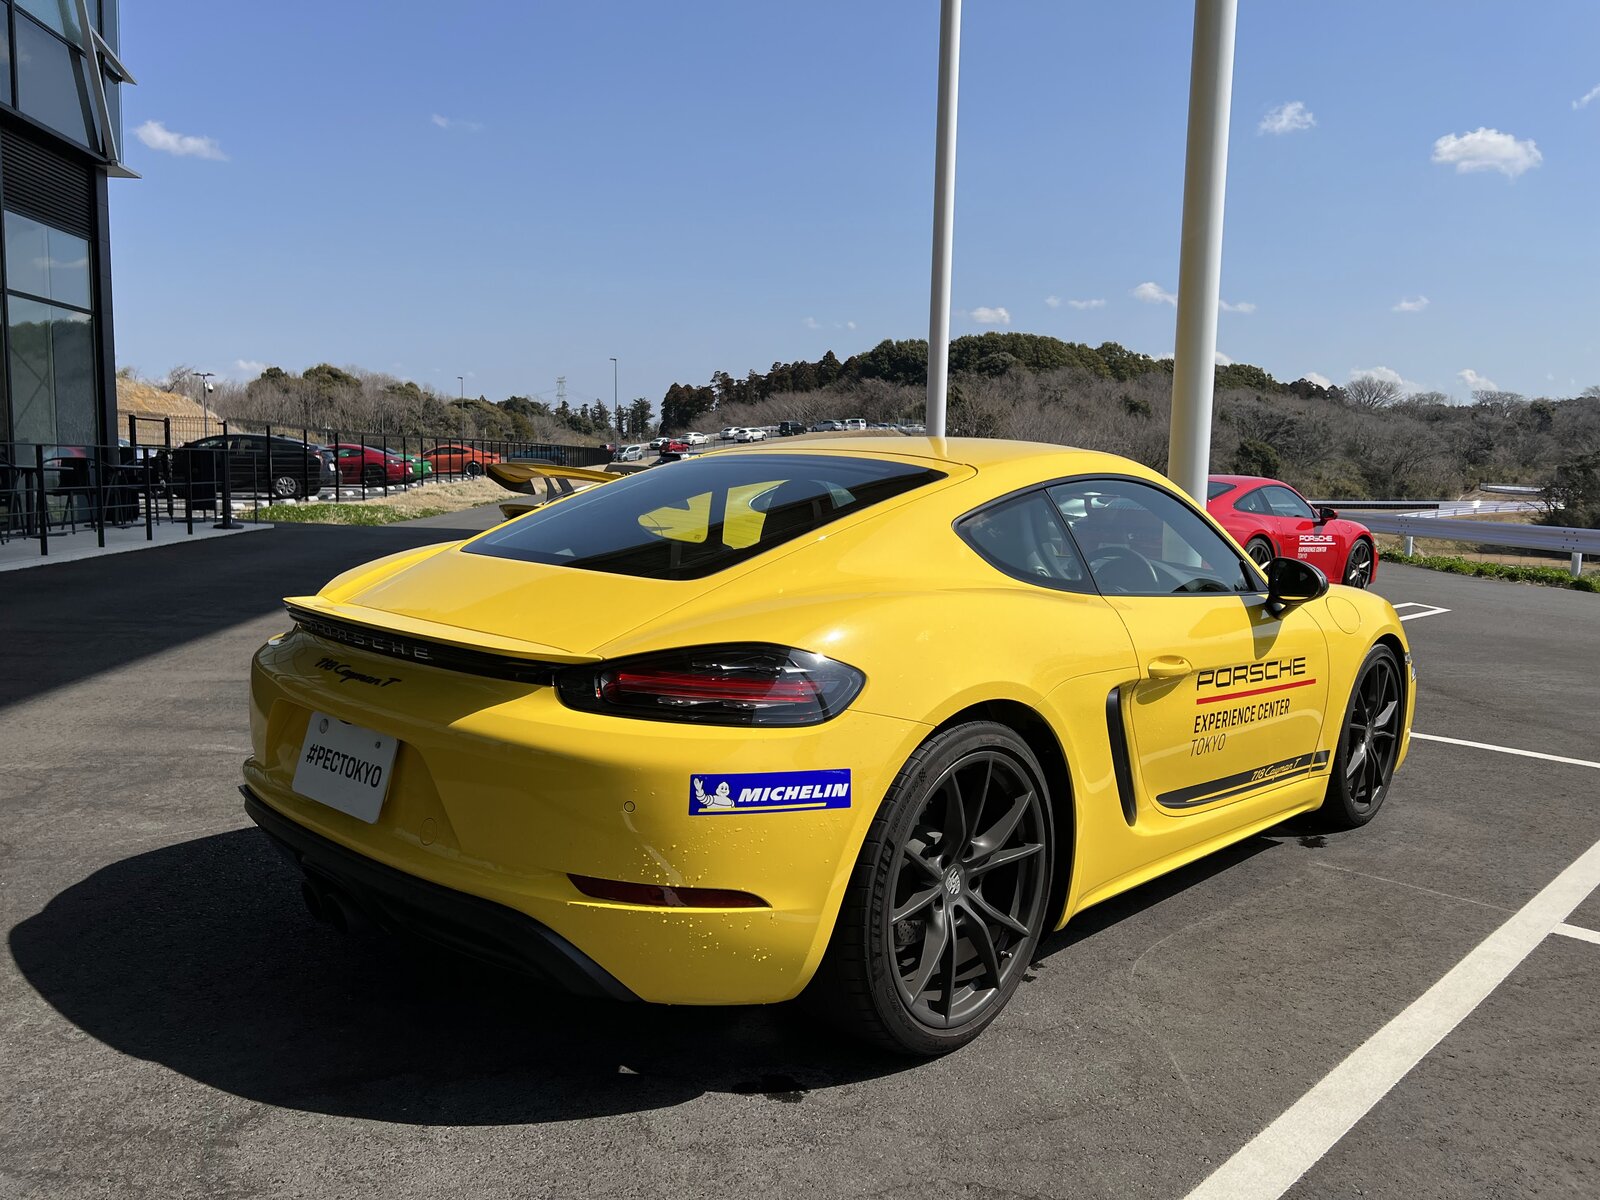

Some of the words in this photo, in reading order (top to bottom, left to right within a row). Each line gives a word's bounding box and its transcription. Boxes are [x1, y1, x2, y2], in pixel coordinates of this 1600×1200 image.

[307, 622, 433, 660] PORSCHE
[333, 663, 384, 685] Cayman
[380, 676, 403, 687] T
[1196, 656, 1306, 691] PORSCHE
[1193, 704, 1256, 734] EXPERIENCE
[1257, 697, 1291, 720] CENTER
[1190, 733, 1227, 757] TOKYO
[305, 743, 384, 789] #PECTOKYO
[1251, 768, 1265, 782] 718
[1264, 762, 1294, 782] Cayman
[1292, 757, 1303, 770] T
[737, 782, 849, 803] MICHELIN
[871, 843, 894, 955] MICHELIN
